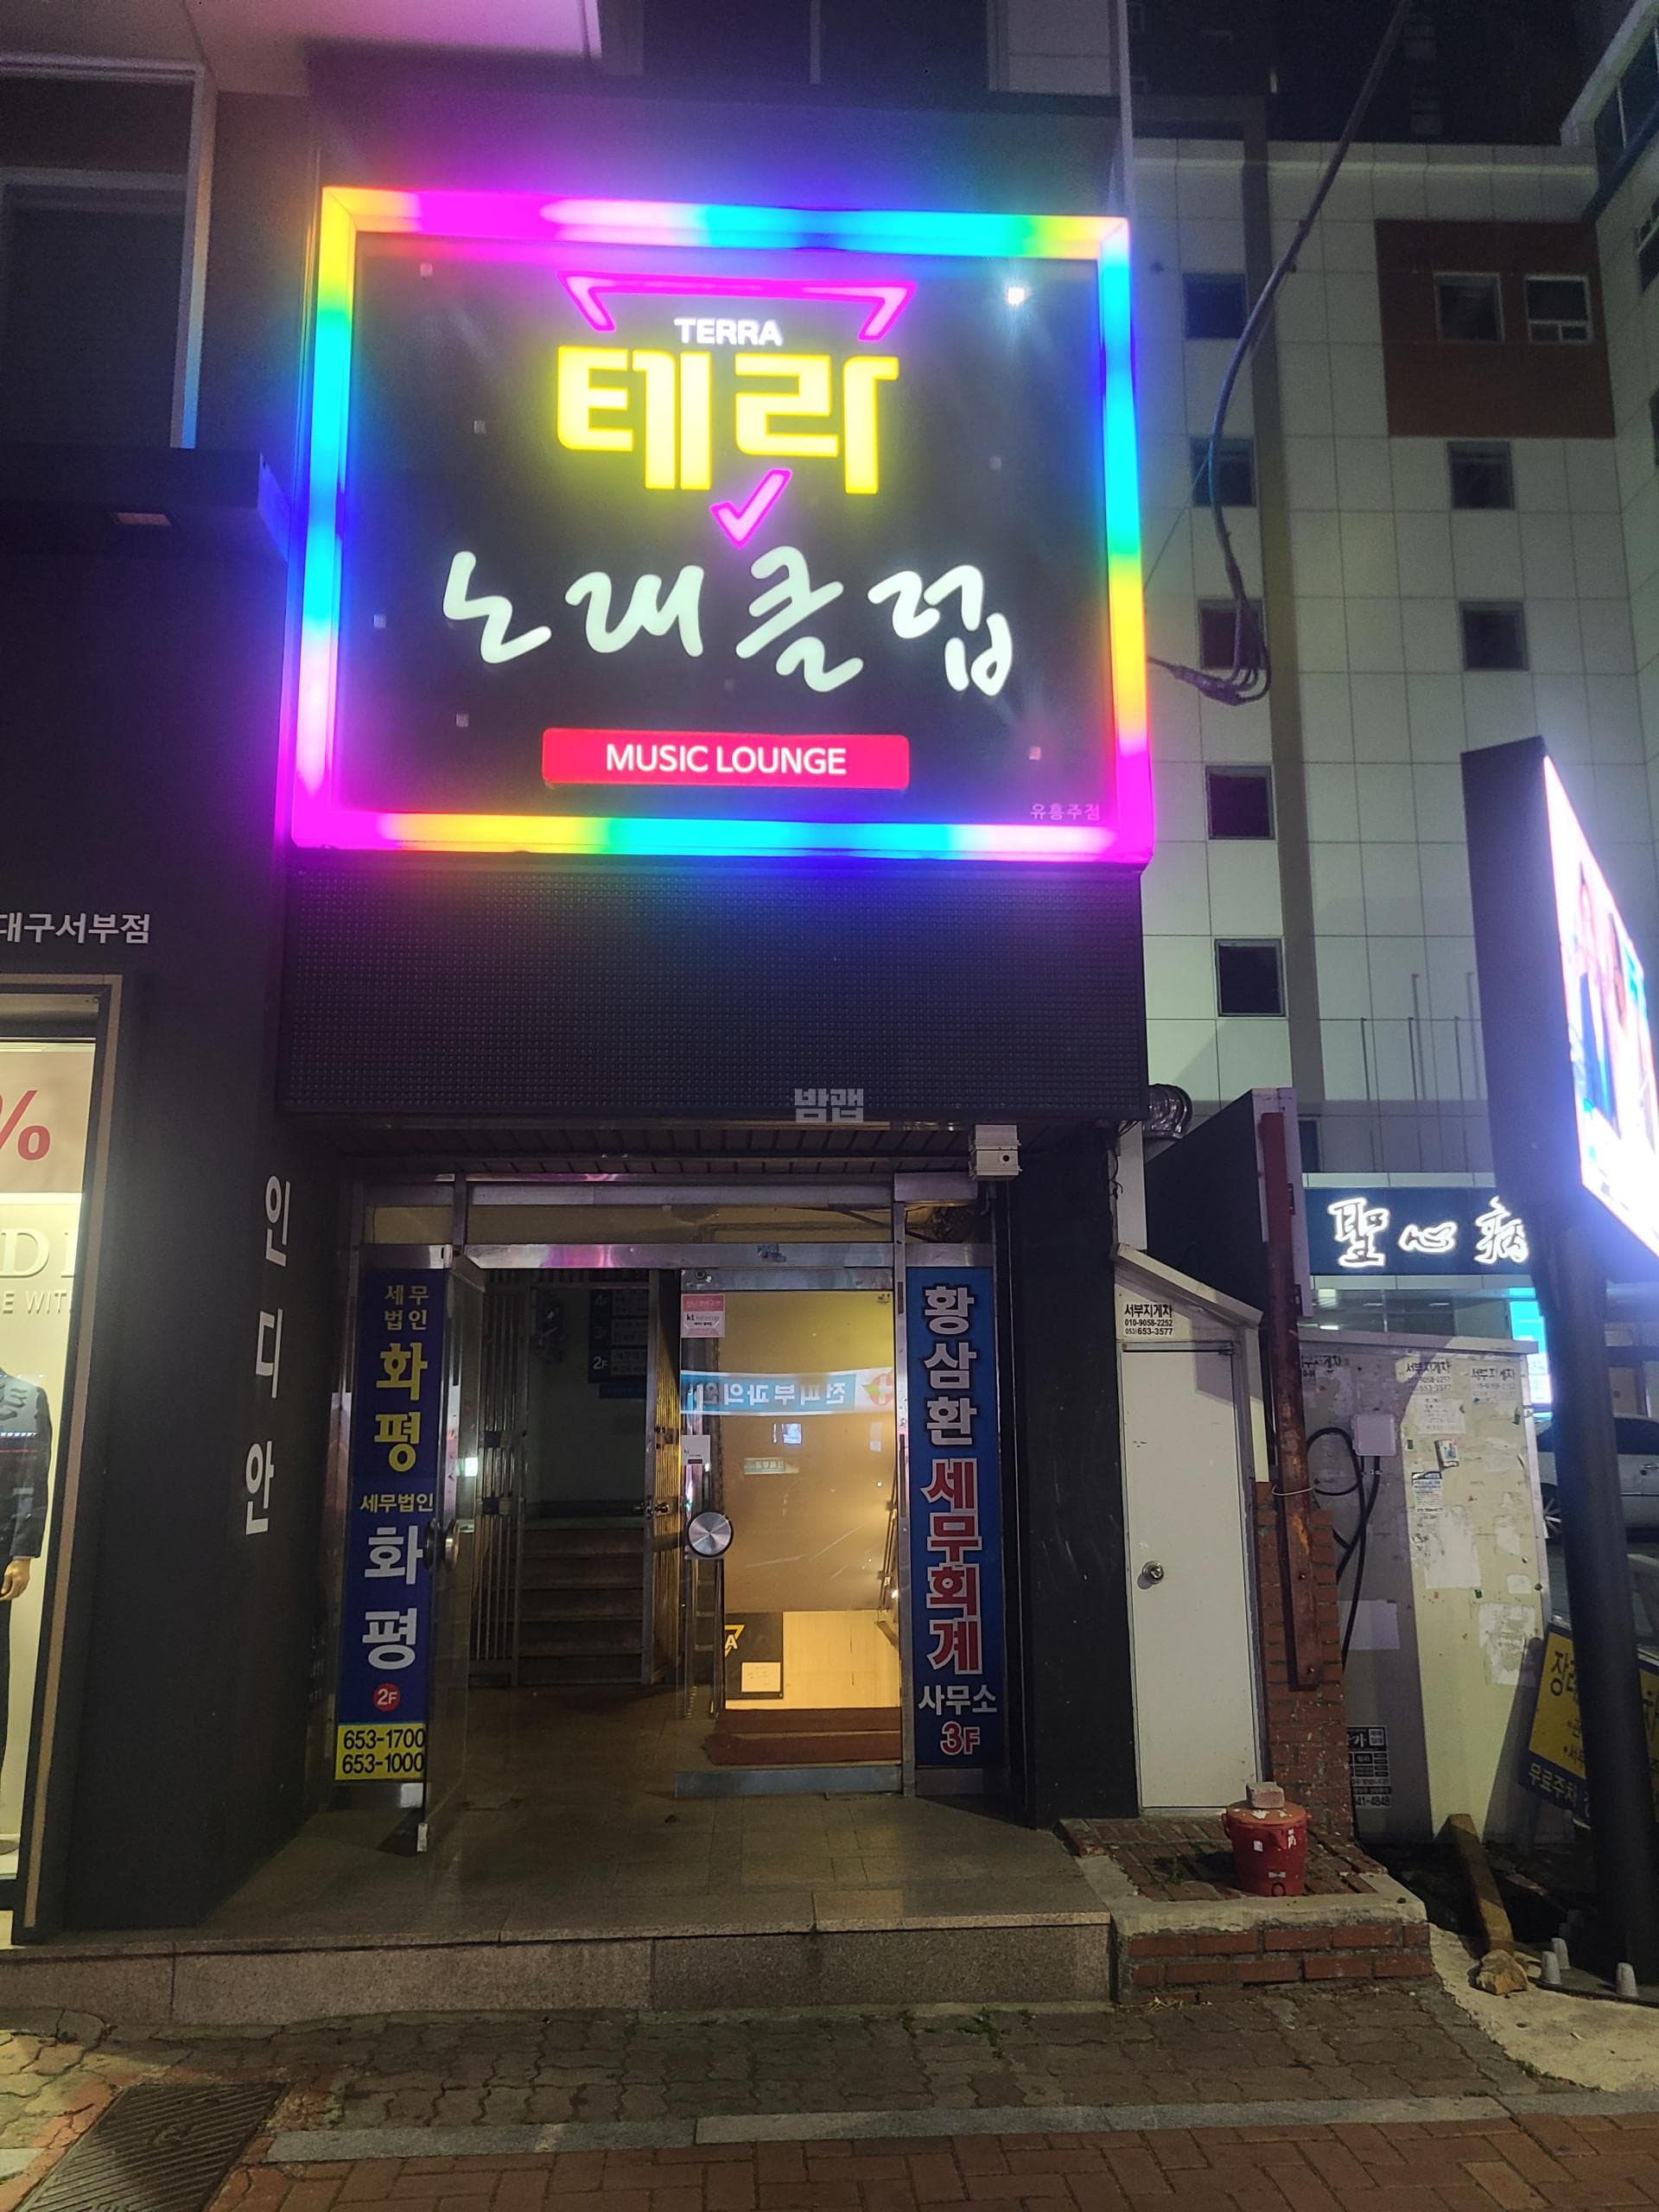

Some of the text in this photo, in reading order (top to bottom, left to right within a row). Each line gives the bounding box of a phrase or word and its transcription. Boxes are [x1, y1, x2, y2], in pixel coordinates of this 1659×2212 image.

[674, 317, 783, 347] TERRA
[556, 346, 899, 495] 테라
[442, 544, 1014, 696] 노래클럽
[605, 742, 848, 777] MUSIC LOUNGE
[1031, 803, 1100, 822] 유흥주점
[384, 1284, 429, 1306] 세무
[384, 1309, 429, 1332] 법인
[1124, 1304, 1173, 1319] 서부지게차
[1124, 1319, 1173, 1327] 010-9058-2252
[245, 1175, 292, 1535] 인디안
[922, 1285, 978, 1447] 황삼환
[373, 1342, 429, 1473] 화평
[359, 1492, 435, 1515] 세무법인
[919, 1457, 984, 1676] 세무회계
[362, 1524, 425, 1671] 화평
[377, 1688, 397, 1707] 2F
[918, 1683, 998, 1716] 사무소
[343, 1729, 425, 1751] 653-1700
[939, 1721, 982, 1757] 3F
[341, 1754, 425, 1776] 653-1000
